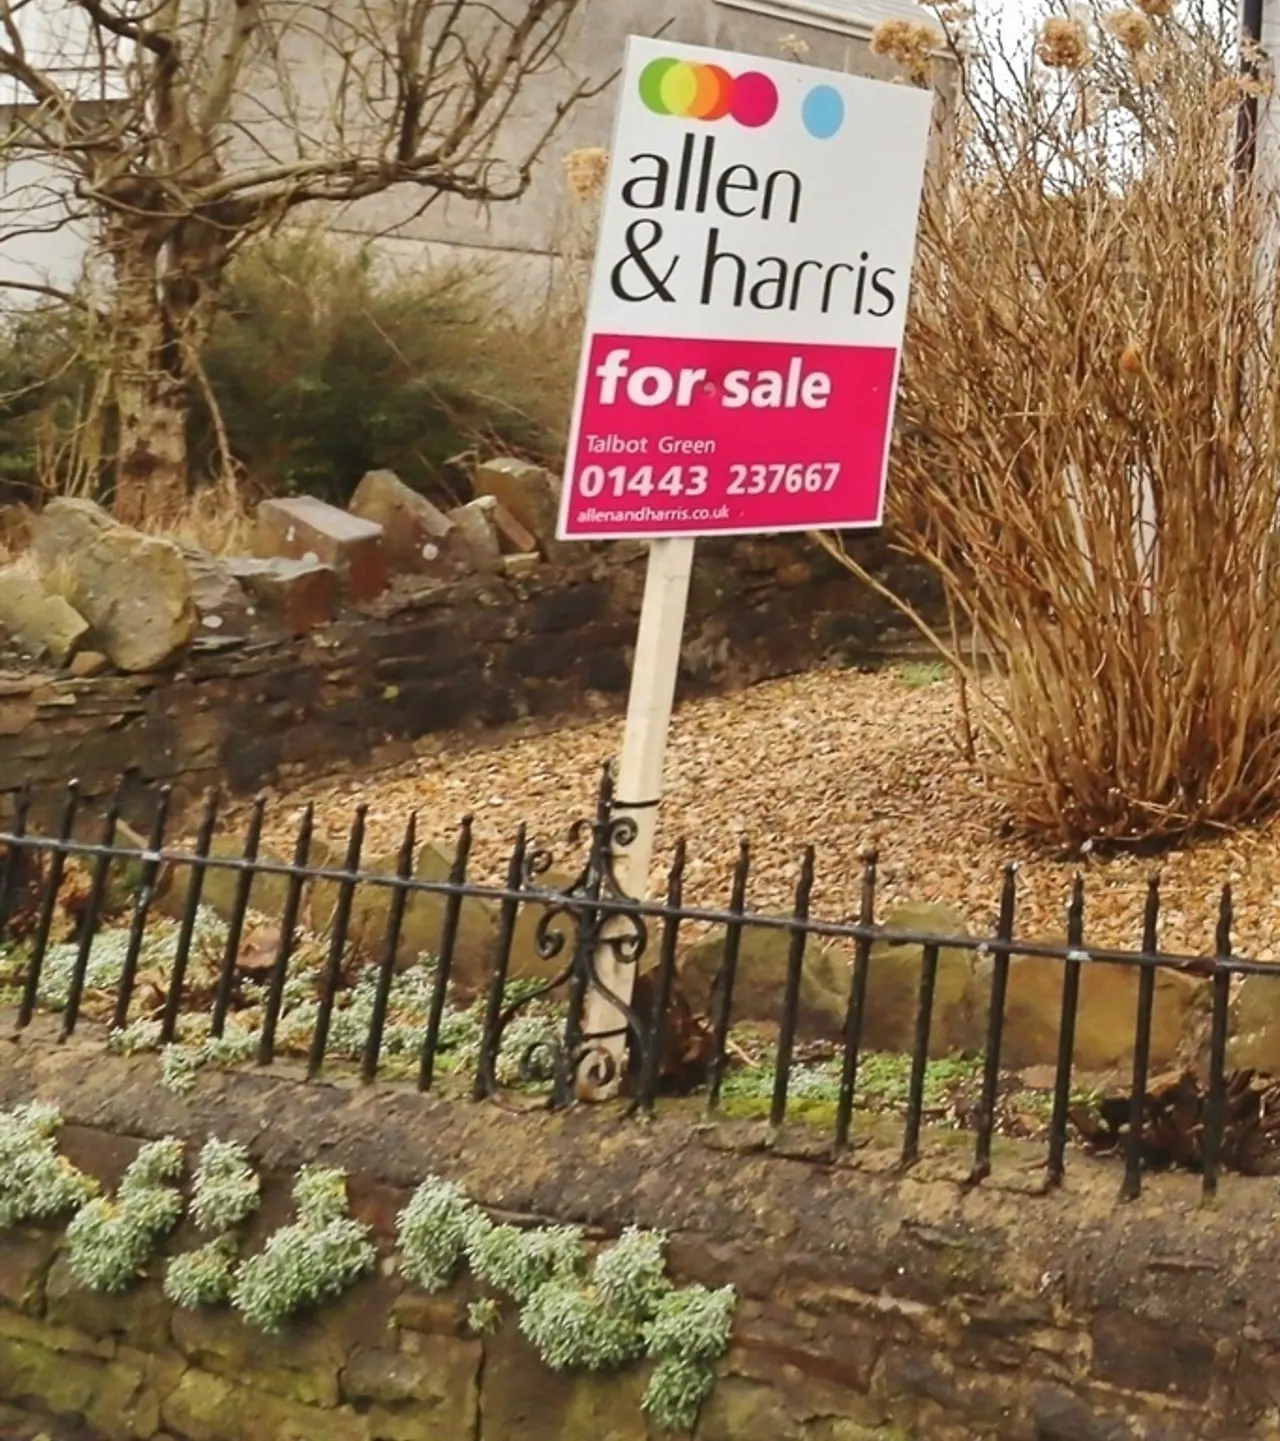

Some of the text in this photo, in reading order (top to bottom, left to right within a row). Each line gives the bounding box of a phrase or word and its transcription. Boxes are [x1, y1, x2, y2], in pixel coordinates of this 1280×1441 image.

[621, 132, 802, 223] allen
[610, 218, 897, 318] & harris
[596, 348, 832, 409] for sale
[586, 433, 716, 455] Talbot Green
[578, 462, 841, 498] 01443 237667
[576, 506, 730, 523] allenandharris.co.uk
